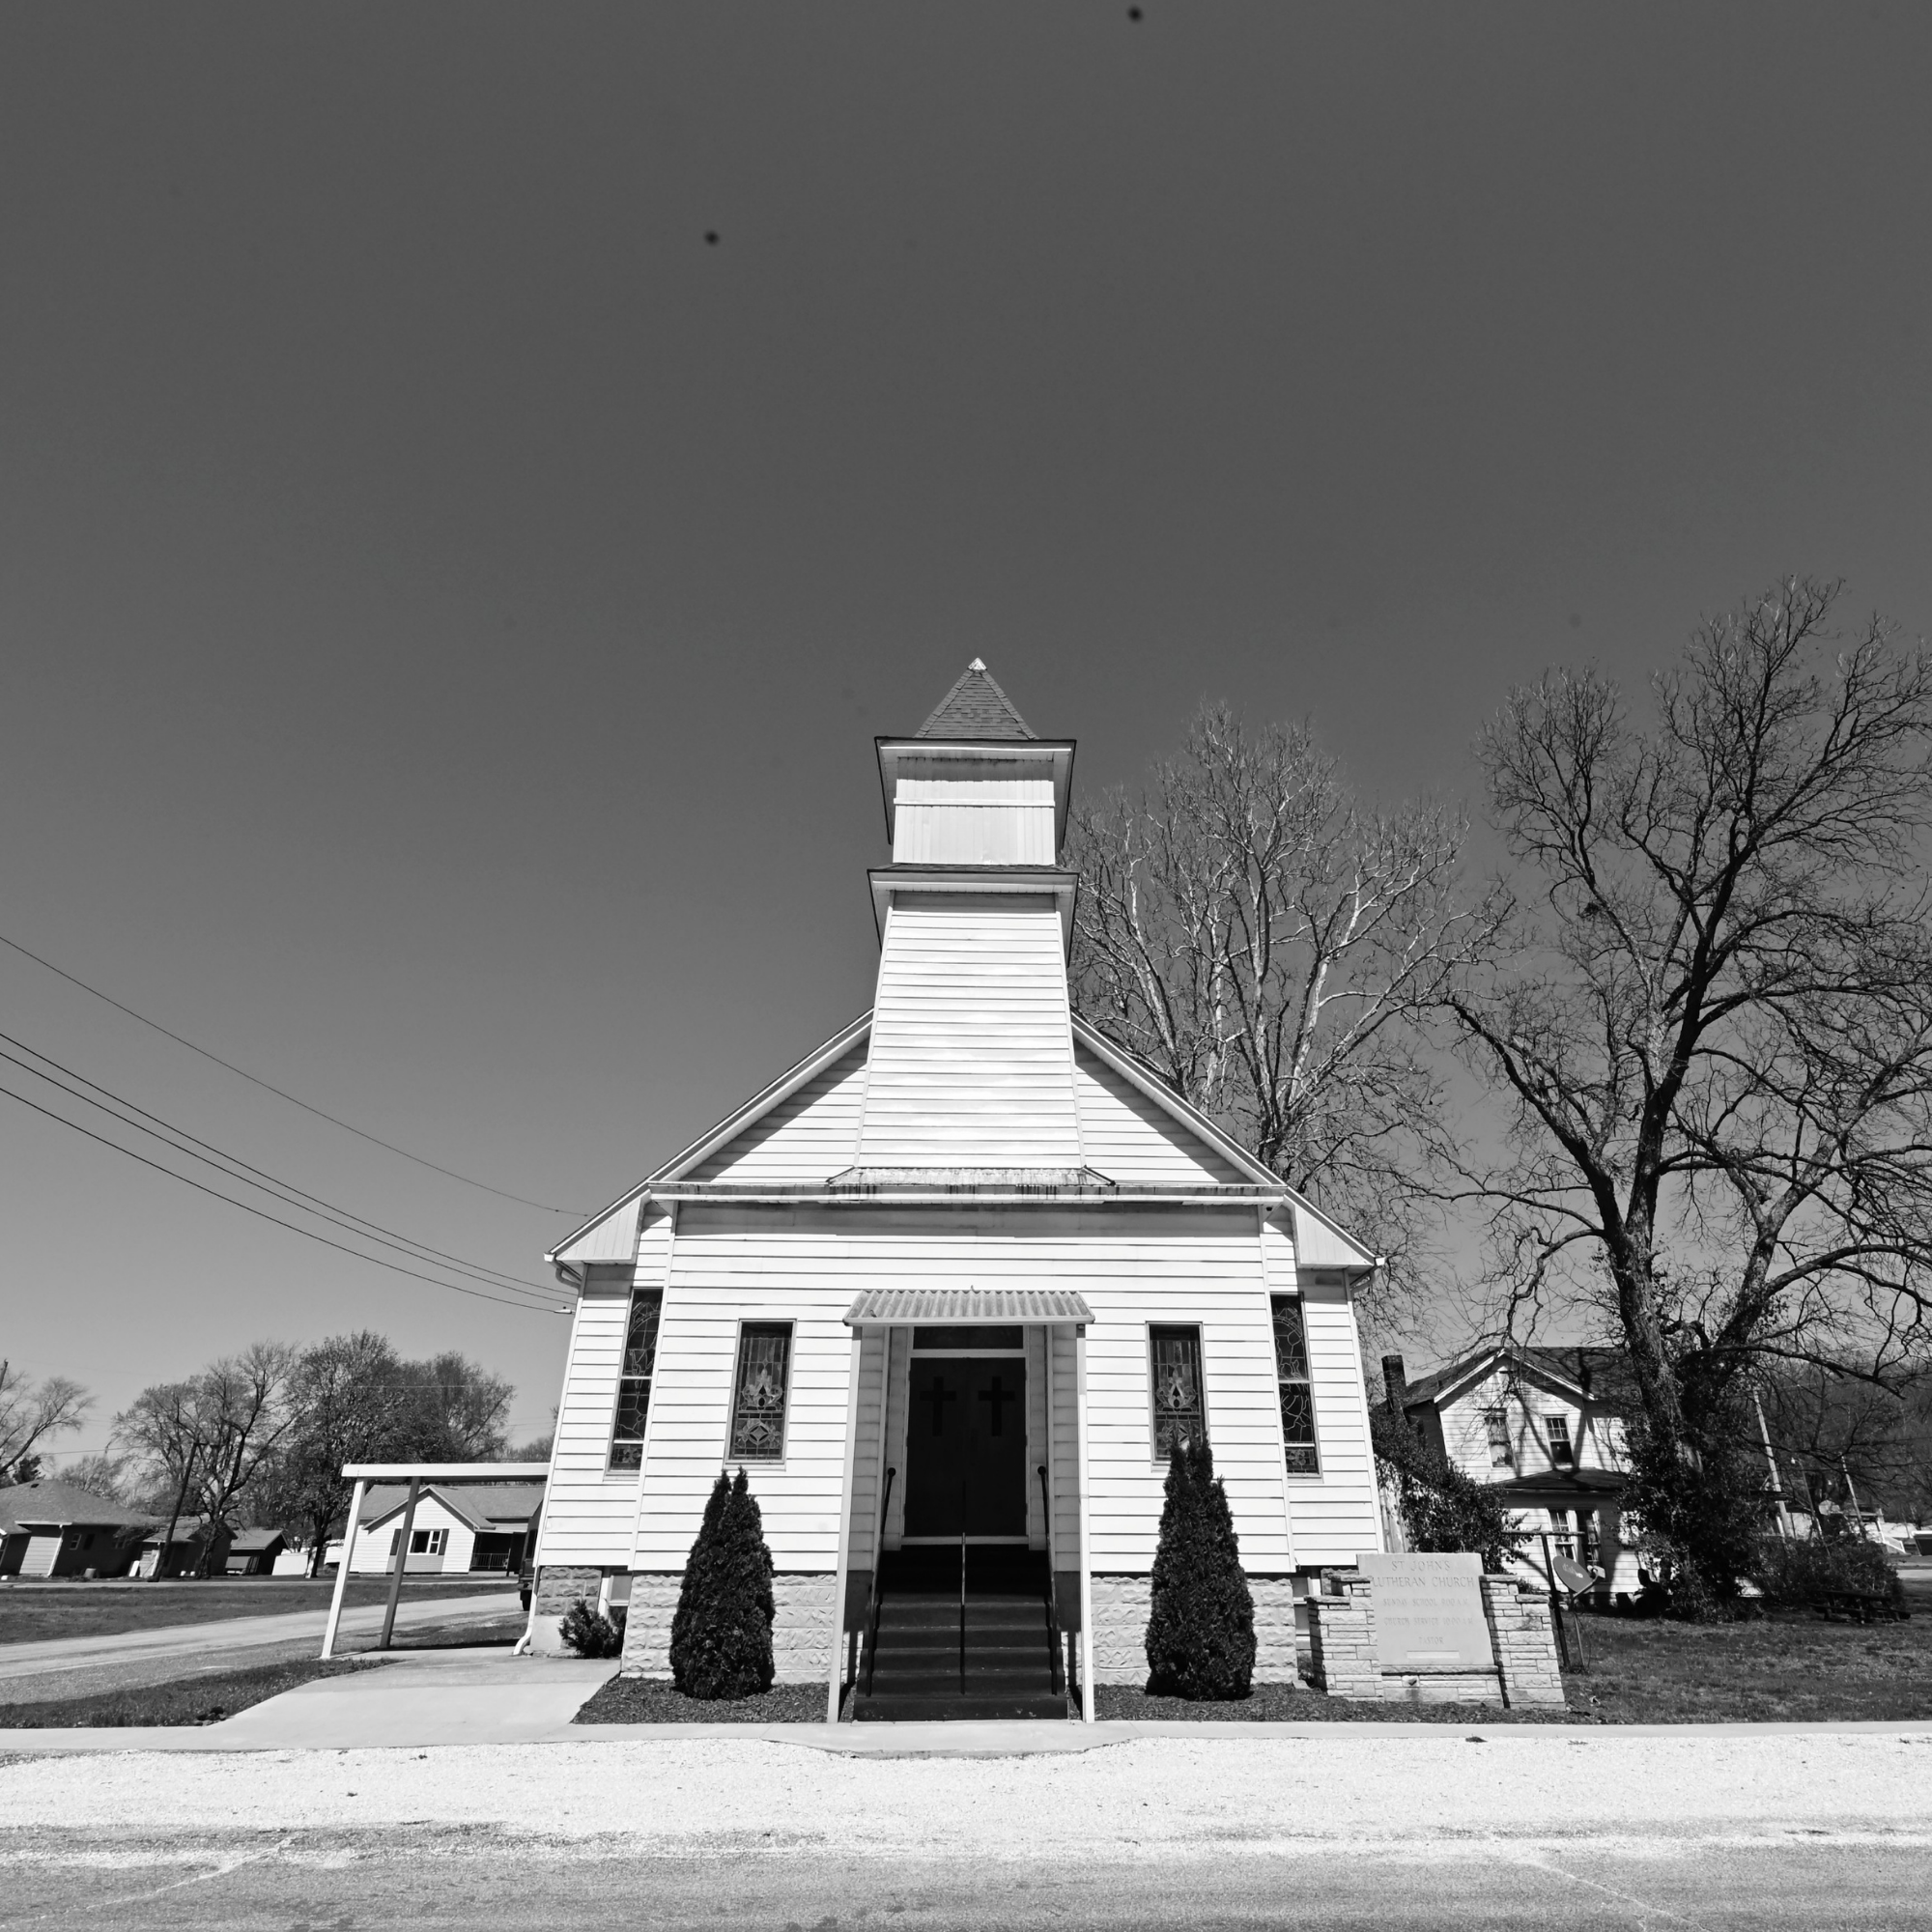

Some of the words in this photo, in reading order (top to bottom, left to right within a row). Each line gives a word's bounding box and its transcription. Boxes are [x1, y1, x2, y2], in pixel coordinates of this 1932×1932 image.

[1372, 1577, 1425, 1587] LUTHERAN
[1433, 1577, 1474, 1587] CHURCH
[1382, 1598, 1407, 1606] SUNDAY
[1412, 1598, 1437, 1606] SCHOOL
[1383, 1617, 1410, 1626] CHURCH
[1413, 1617, 1438, 1626] SERVICE
